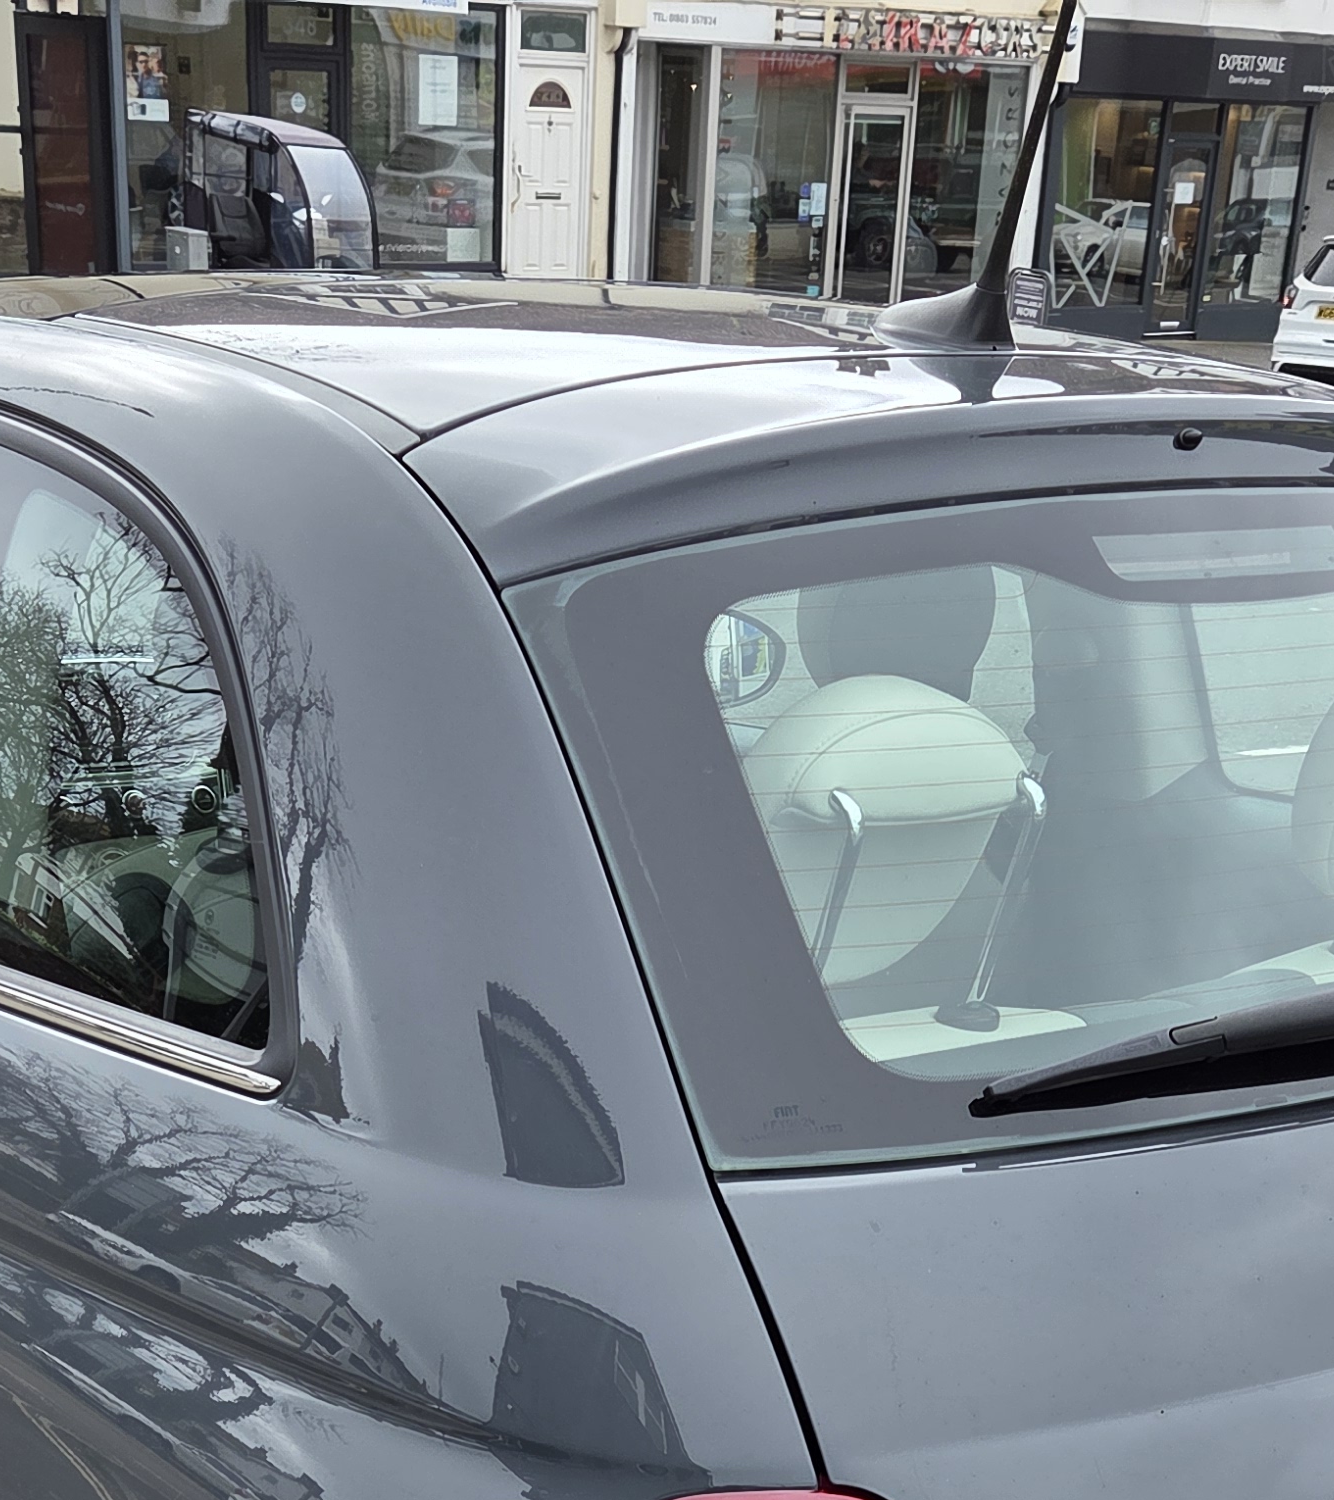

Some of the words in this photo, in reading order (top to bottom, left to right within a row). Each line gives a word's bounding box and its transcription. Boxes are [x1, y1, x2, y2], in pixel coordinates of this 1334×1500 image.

[1218, 53, 1256, 72] EXPERT
[1255, 55, 1287, 73] SMILE
[773, 1104, 799, 1118] FIAT
